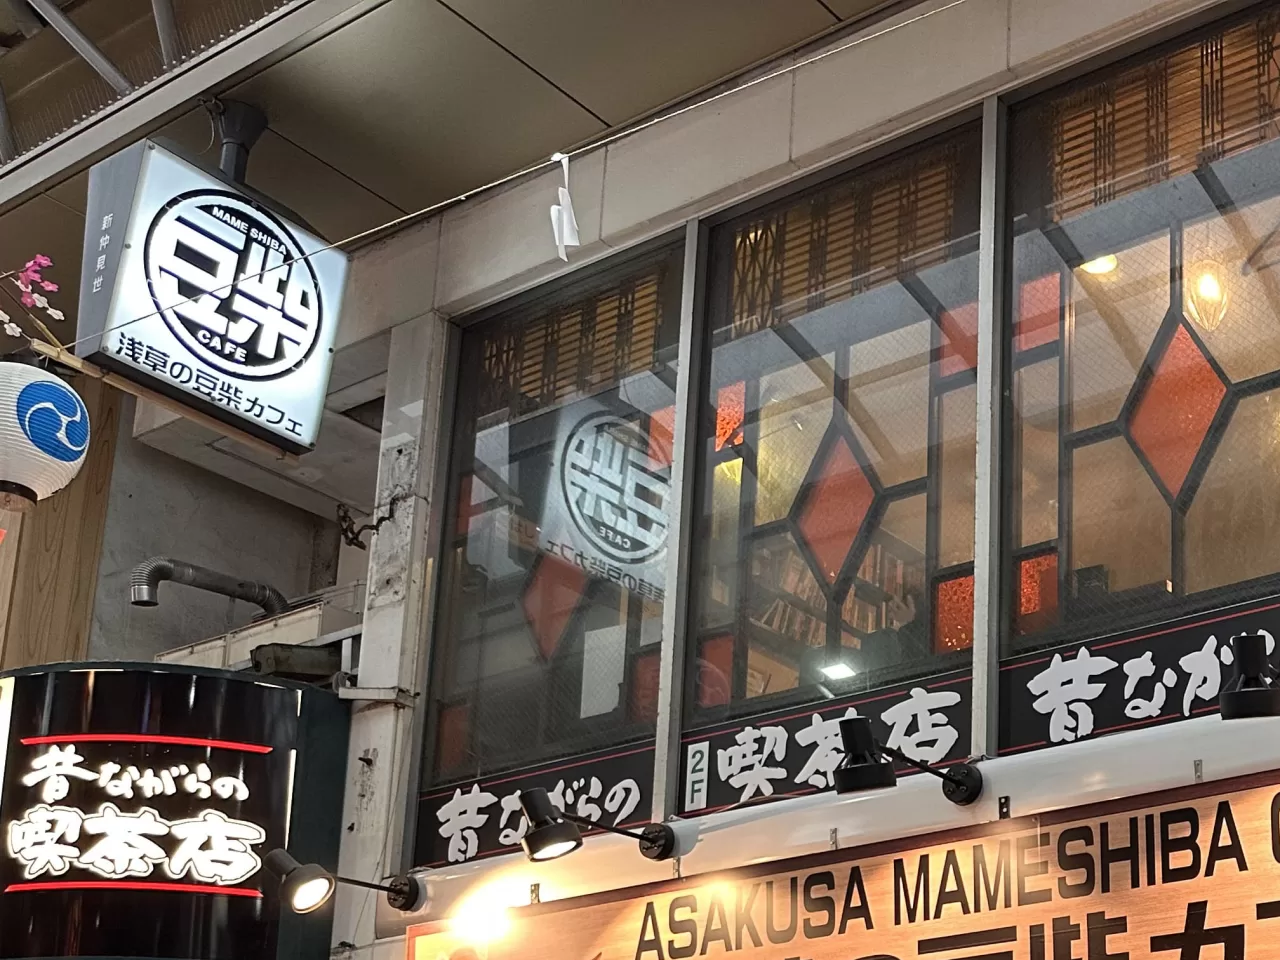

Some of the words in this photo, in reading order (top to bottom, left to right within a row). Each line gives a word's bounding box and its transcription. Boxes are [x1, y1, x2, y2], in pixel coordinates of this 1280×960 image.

[212, 206, 249, 233] MAME
[250, 227, 287, 255] SHIBA
[115, 332, 304, 437] 浅草の豆柴カフェ
[197, 329, 248, 363] CAFE
[22, 743, 250, 804] 昔ながらの
[716, 687, 962, 801] 喫茶店
[9, 803, 267, 886] 喫茶店
[893, 799, 1249, 927] MAMESHIBA
